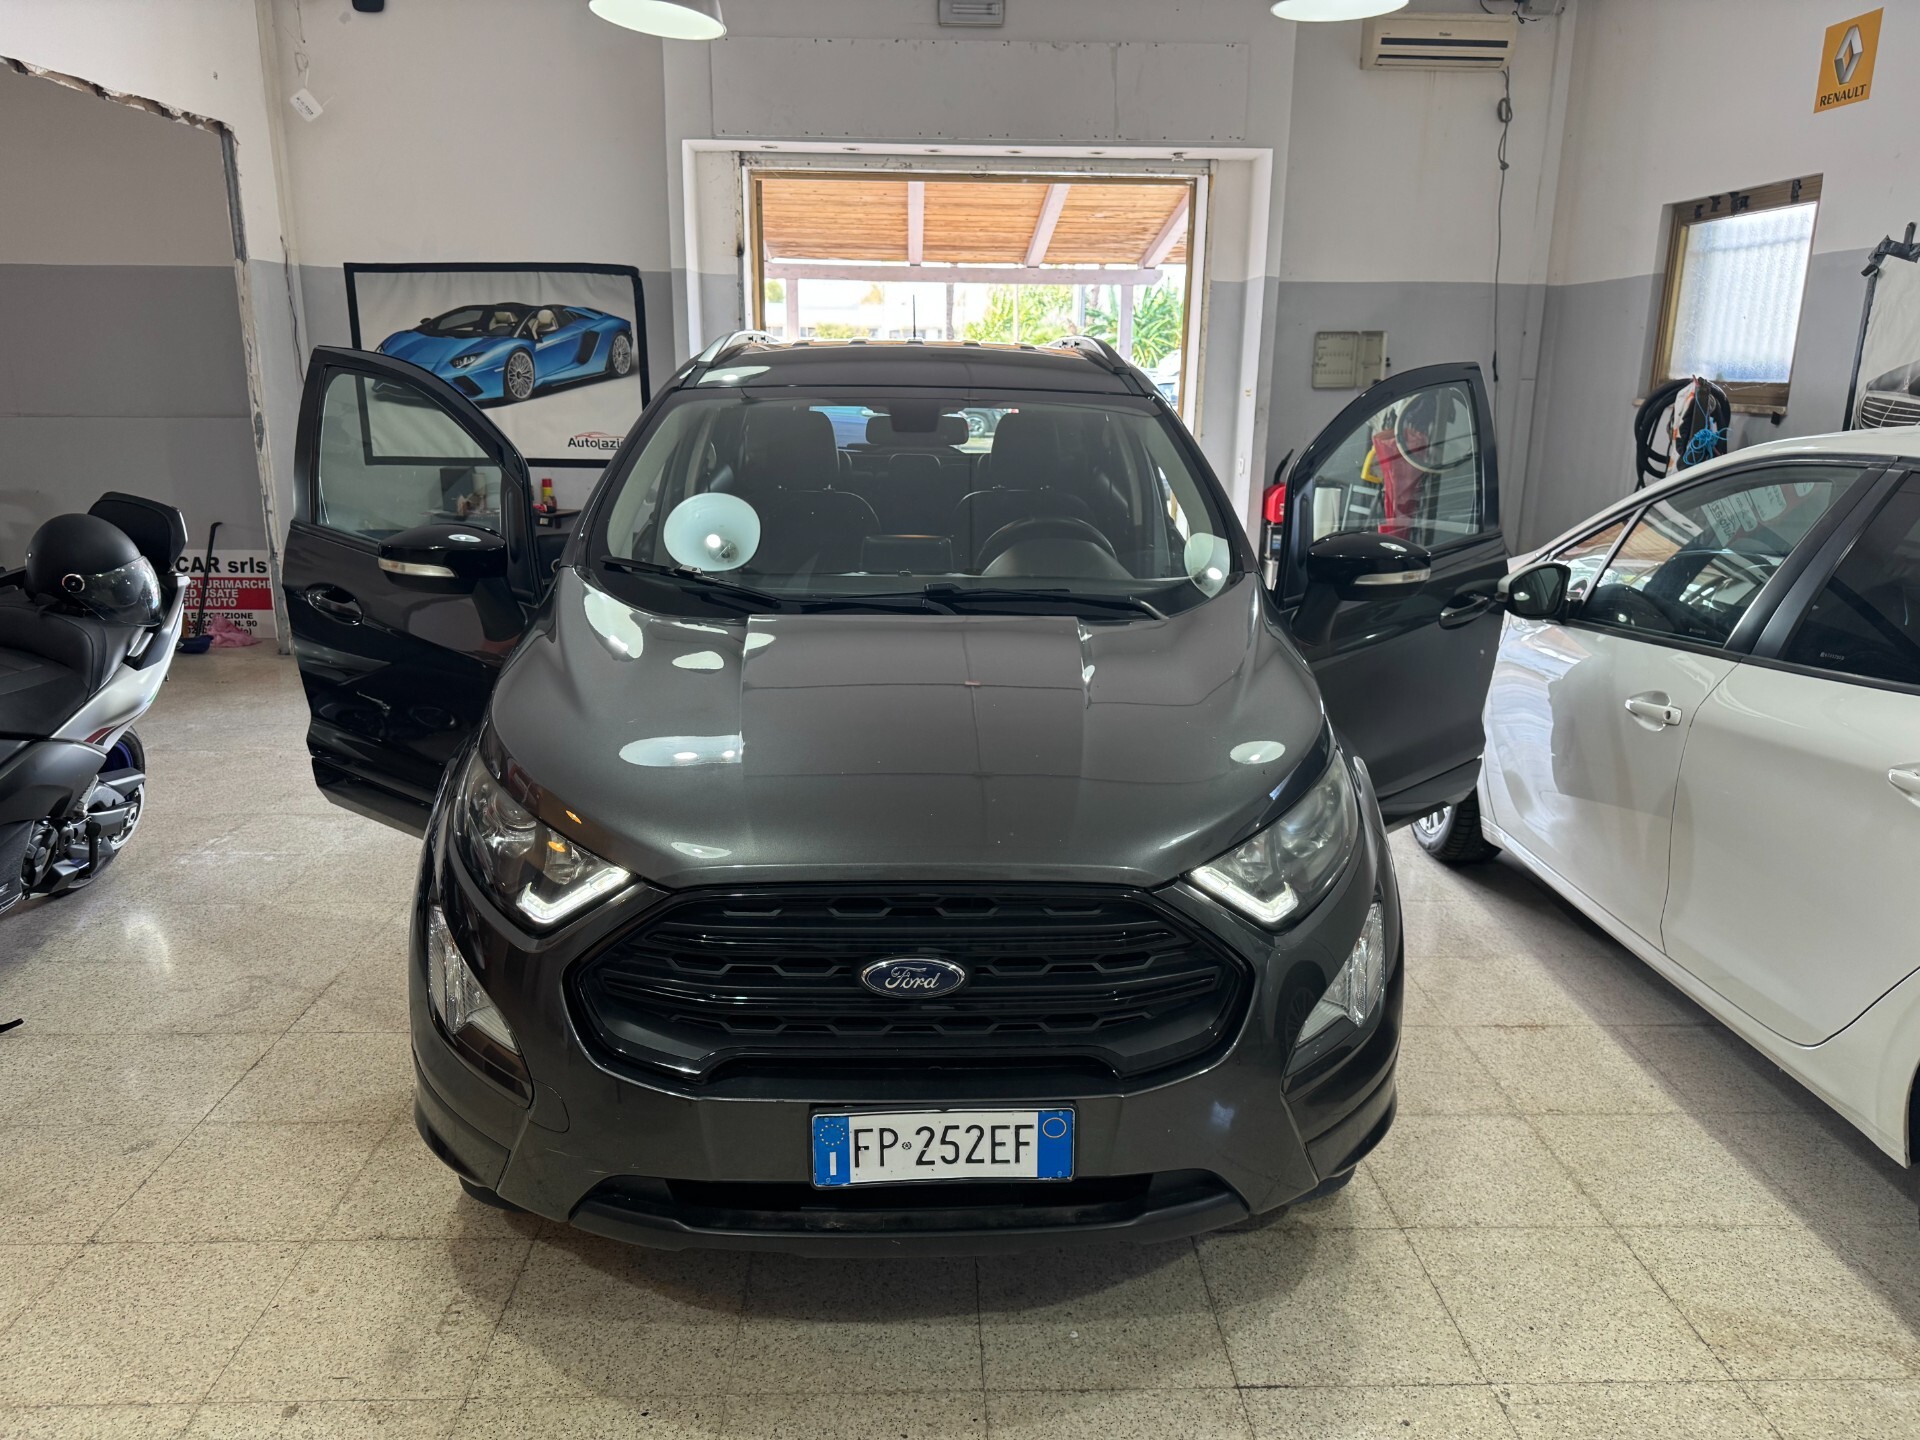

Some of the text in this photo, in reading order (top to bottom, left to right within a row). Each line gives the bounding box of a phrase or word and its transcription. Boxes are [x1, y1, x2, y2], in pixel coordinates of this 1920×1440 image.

[1819, 84, 1867, 107] RENAULT
[567, 437, 624, 450] AutoLazi
[175, 556, 268, 574] CAR srls
[205, 597, 237, 607] AUTO
[885, 966, 941, 989] Ford
[854, 1124, 1035, 1168] FP 252EF
